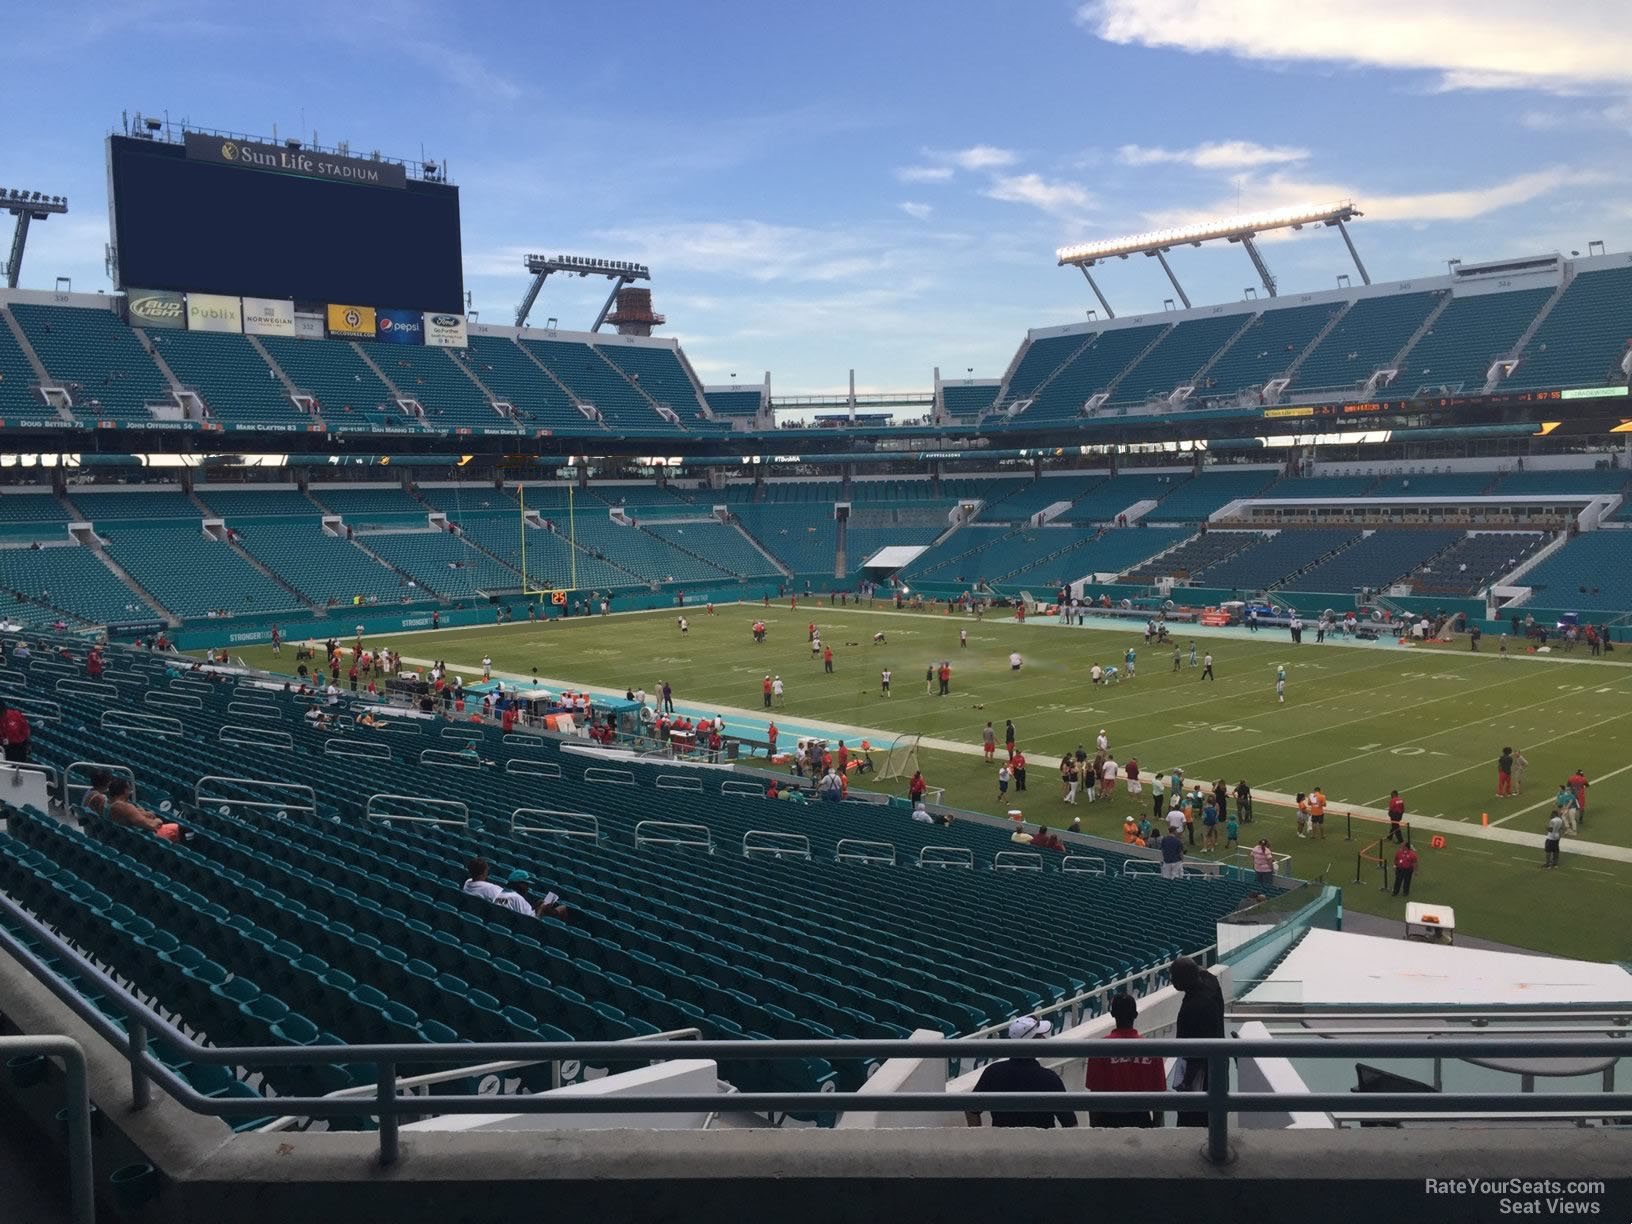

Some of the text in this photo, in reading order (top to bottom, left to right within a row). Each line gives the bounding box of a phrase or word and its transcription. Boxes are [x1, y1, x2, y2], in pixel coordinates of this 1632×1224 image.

[241, 147, 379, 181] Sun Life STADIUM
[145, 300, 181, 310] BUD
[138, 305, 183, 317] LIGHT
[191, 306, 235, 320] Publix
[247, 316, 292, 324] NORWEGIAN
[437, 317, 456, 326] Ford
[394, 322, 420, 332] pepsi
[20, 420, 42, 428] DOUG
[552, 591, 566, 604] 25
